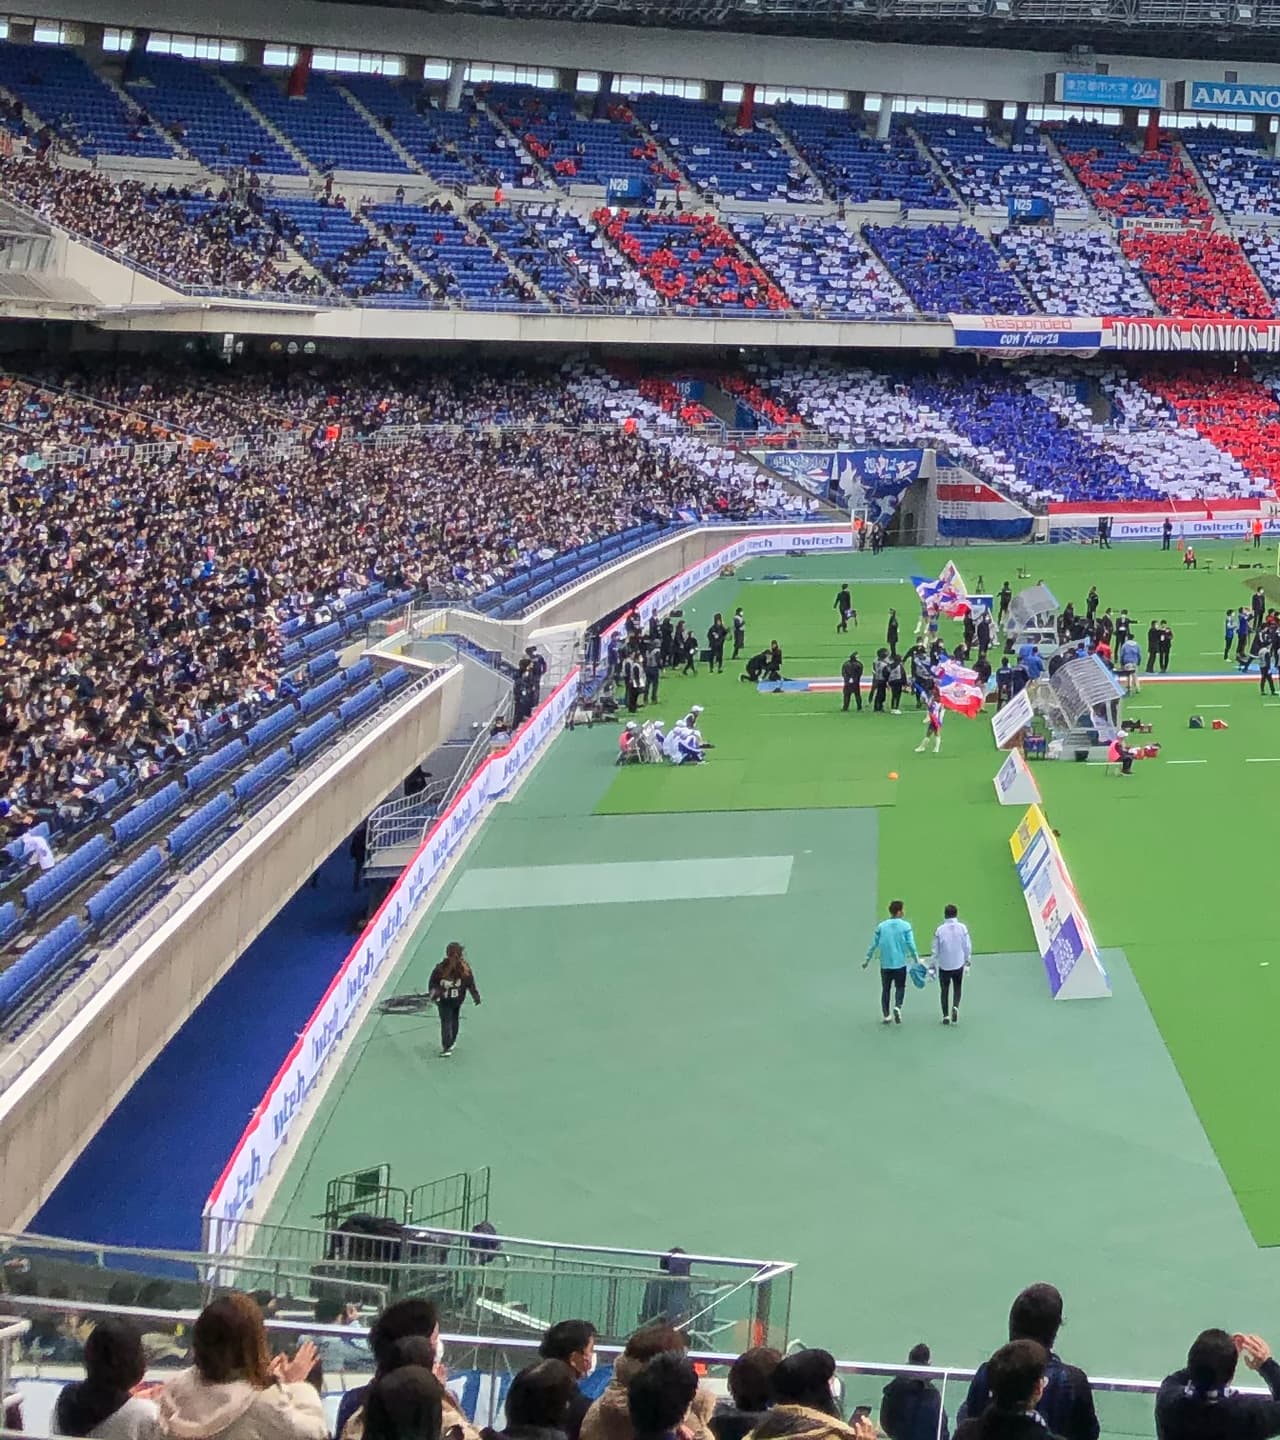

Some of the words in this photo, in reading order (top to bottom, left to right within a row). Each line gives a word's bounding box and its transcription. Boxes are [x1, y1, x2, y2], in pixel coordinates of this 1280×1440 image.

[1013, 199, 1033, 212] N25
[1112, 322, 1183, 351] TODOS
[1191, 323, 1259, 352] SOMOS
[1121, 525, 1165, 536] Owltec
[1192, 521, 1244, 533] Owltech
[792, 534, 844, 547] Owltech
